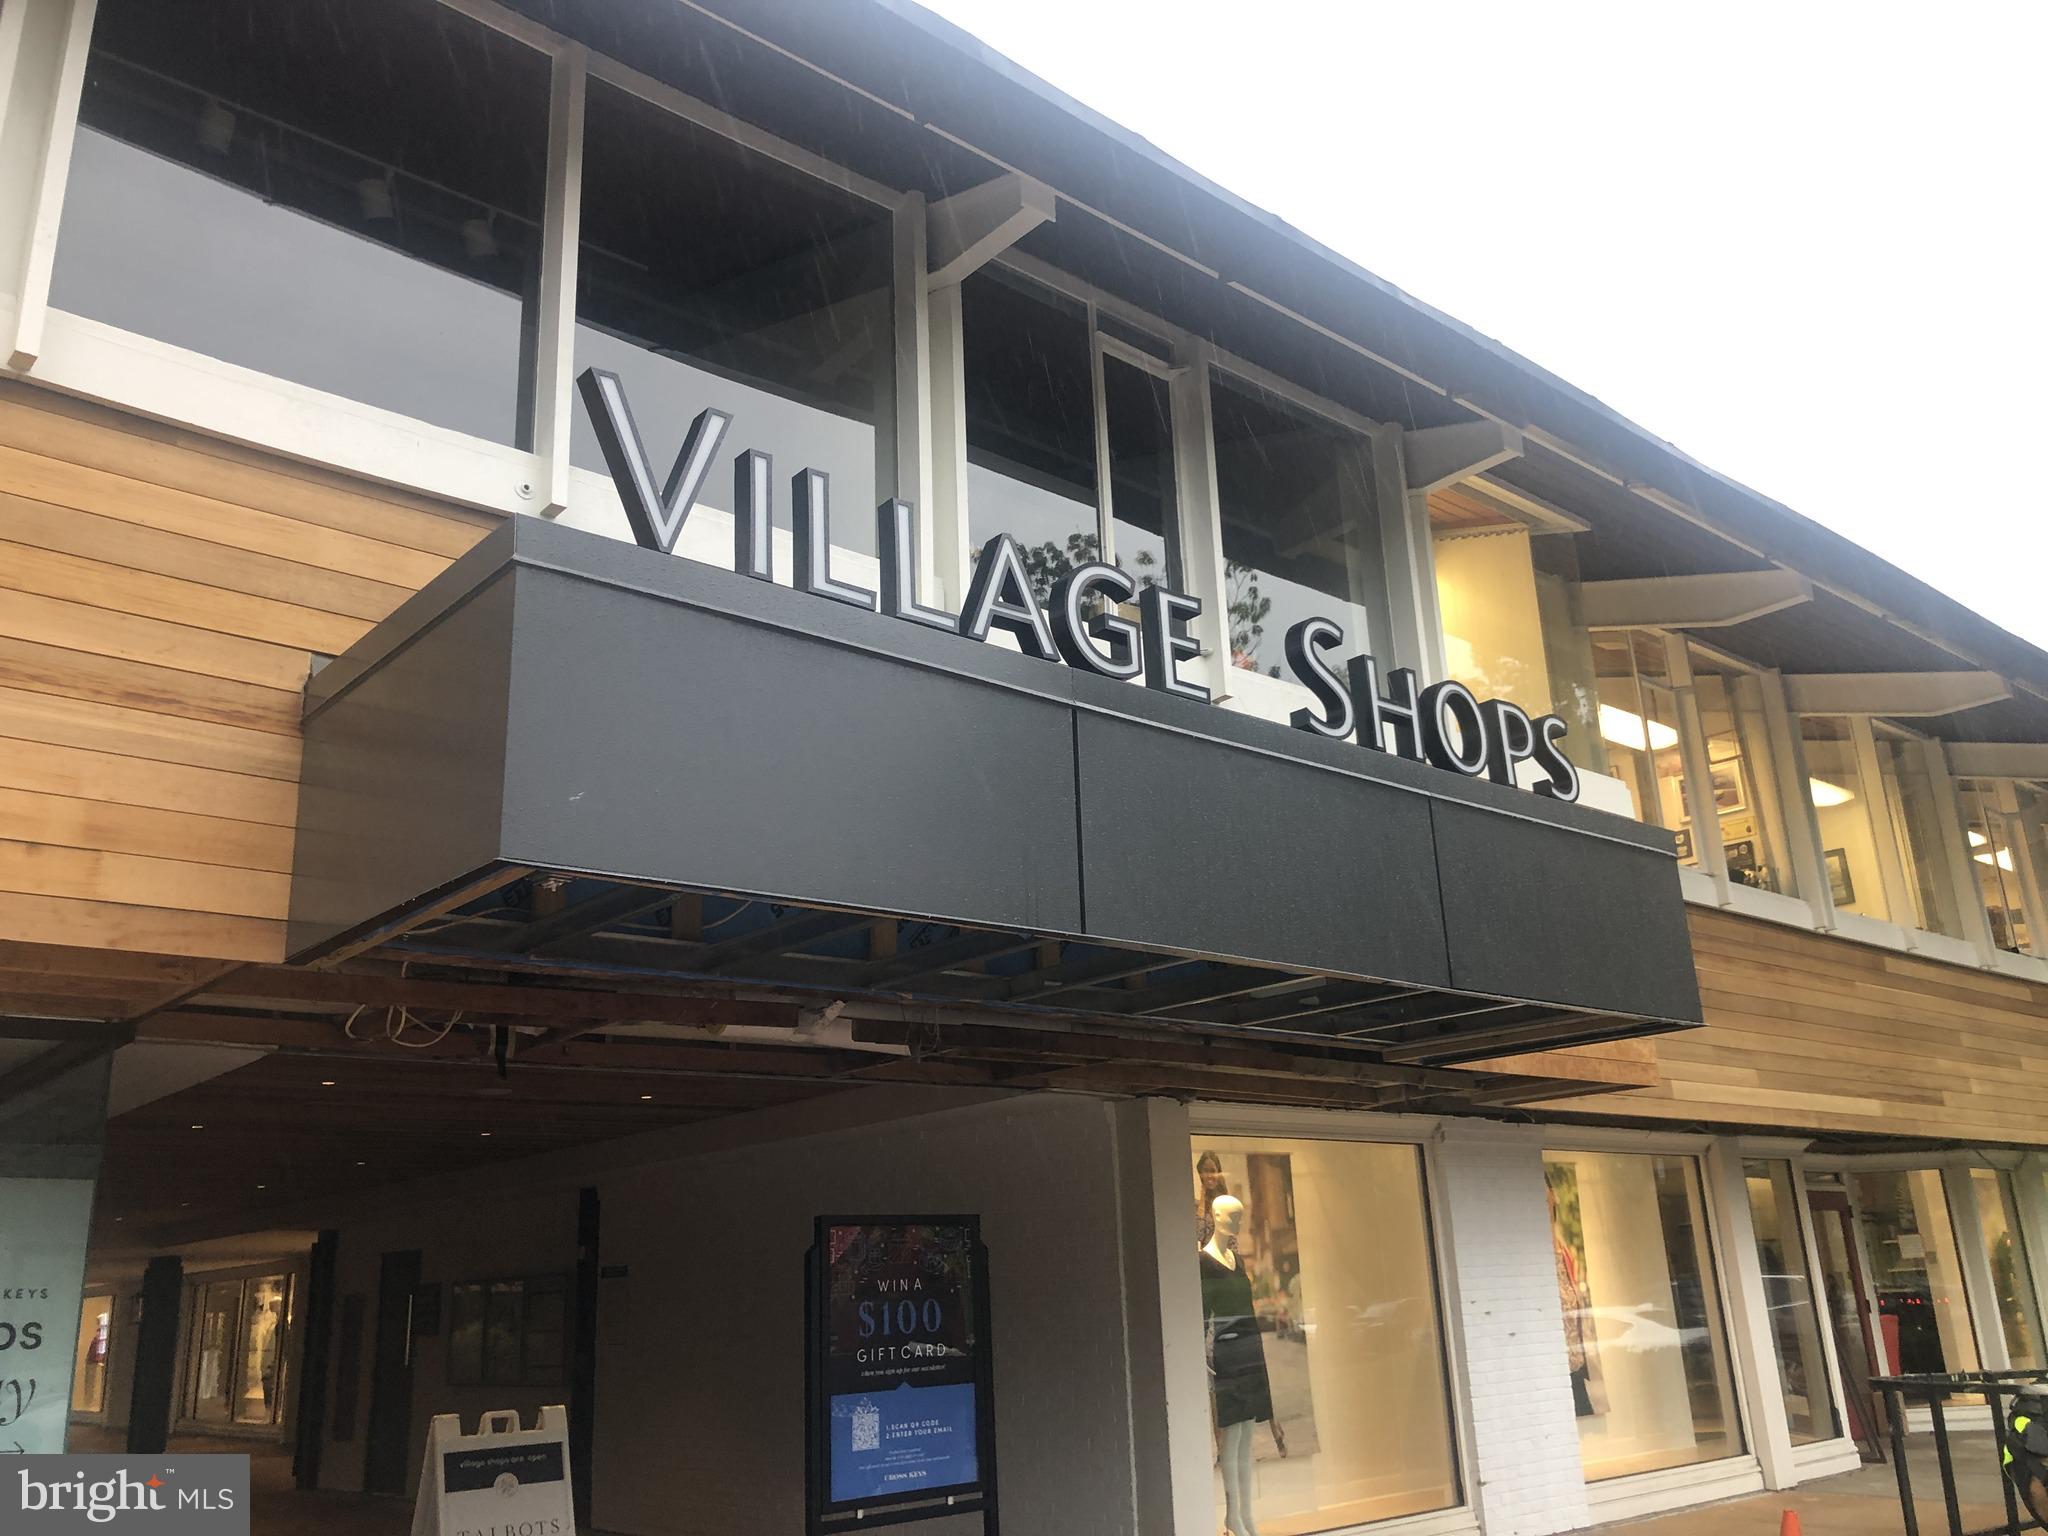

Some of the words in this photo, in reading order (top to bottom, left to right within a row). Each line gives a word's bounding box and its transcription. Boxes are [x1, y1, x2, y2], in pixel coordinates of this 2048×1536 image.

[576, 366, 1212, 703] VILLAGE
[1284, 616, 1580, 803] SHOPS
[3, 1288, 49, 1300] KEYS
[858, 1298, 942, 1339] $100
[857, 1347, 896, 1363] GIFT
[901, 1343, 946, 1359] CARD
